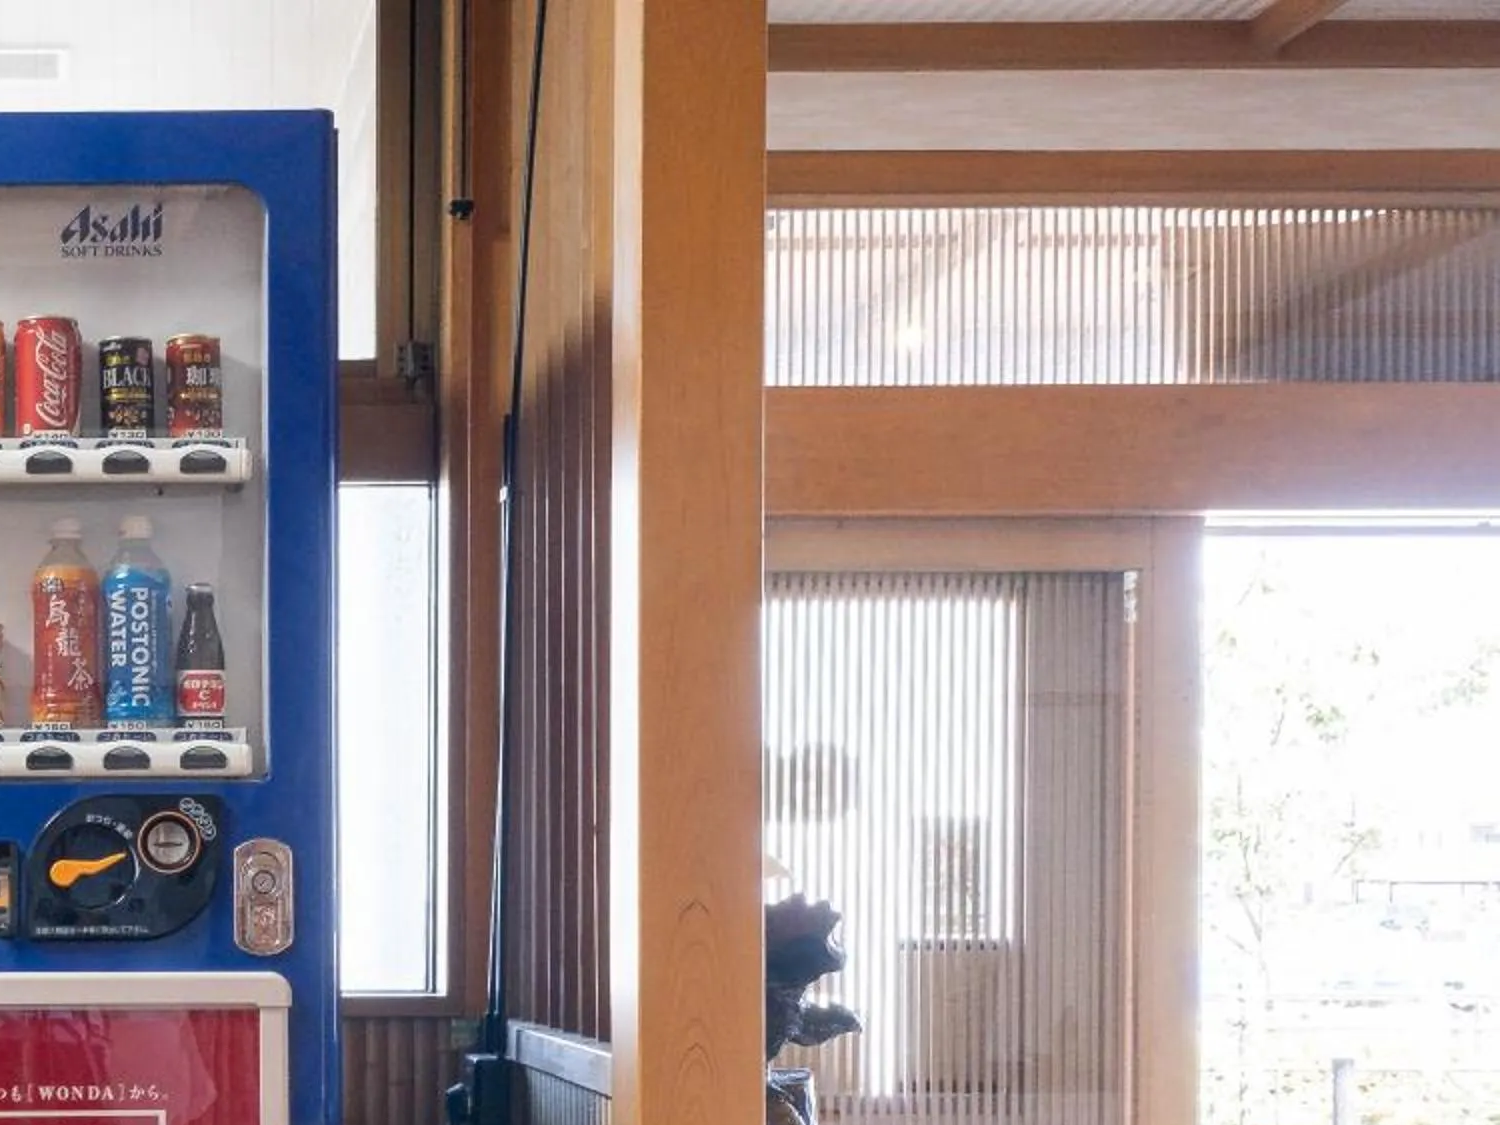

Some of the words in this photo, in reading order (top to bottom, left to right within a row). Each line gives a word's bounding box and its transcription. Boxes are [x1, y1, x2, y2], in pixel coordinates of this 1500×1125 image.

[61, 203, 163, 244] Asahi
[61, 245, 99, 258] SOFT
[104, 245, 163, 257] DRINKS
[109, 590, 127, 668] WATER
[130, 587, 150, 707] POSTONIC
